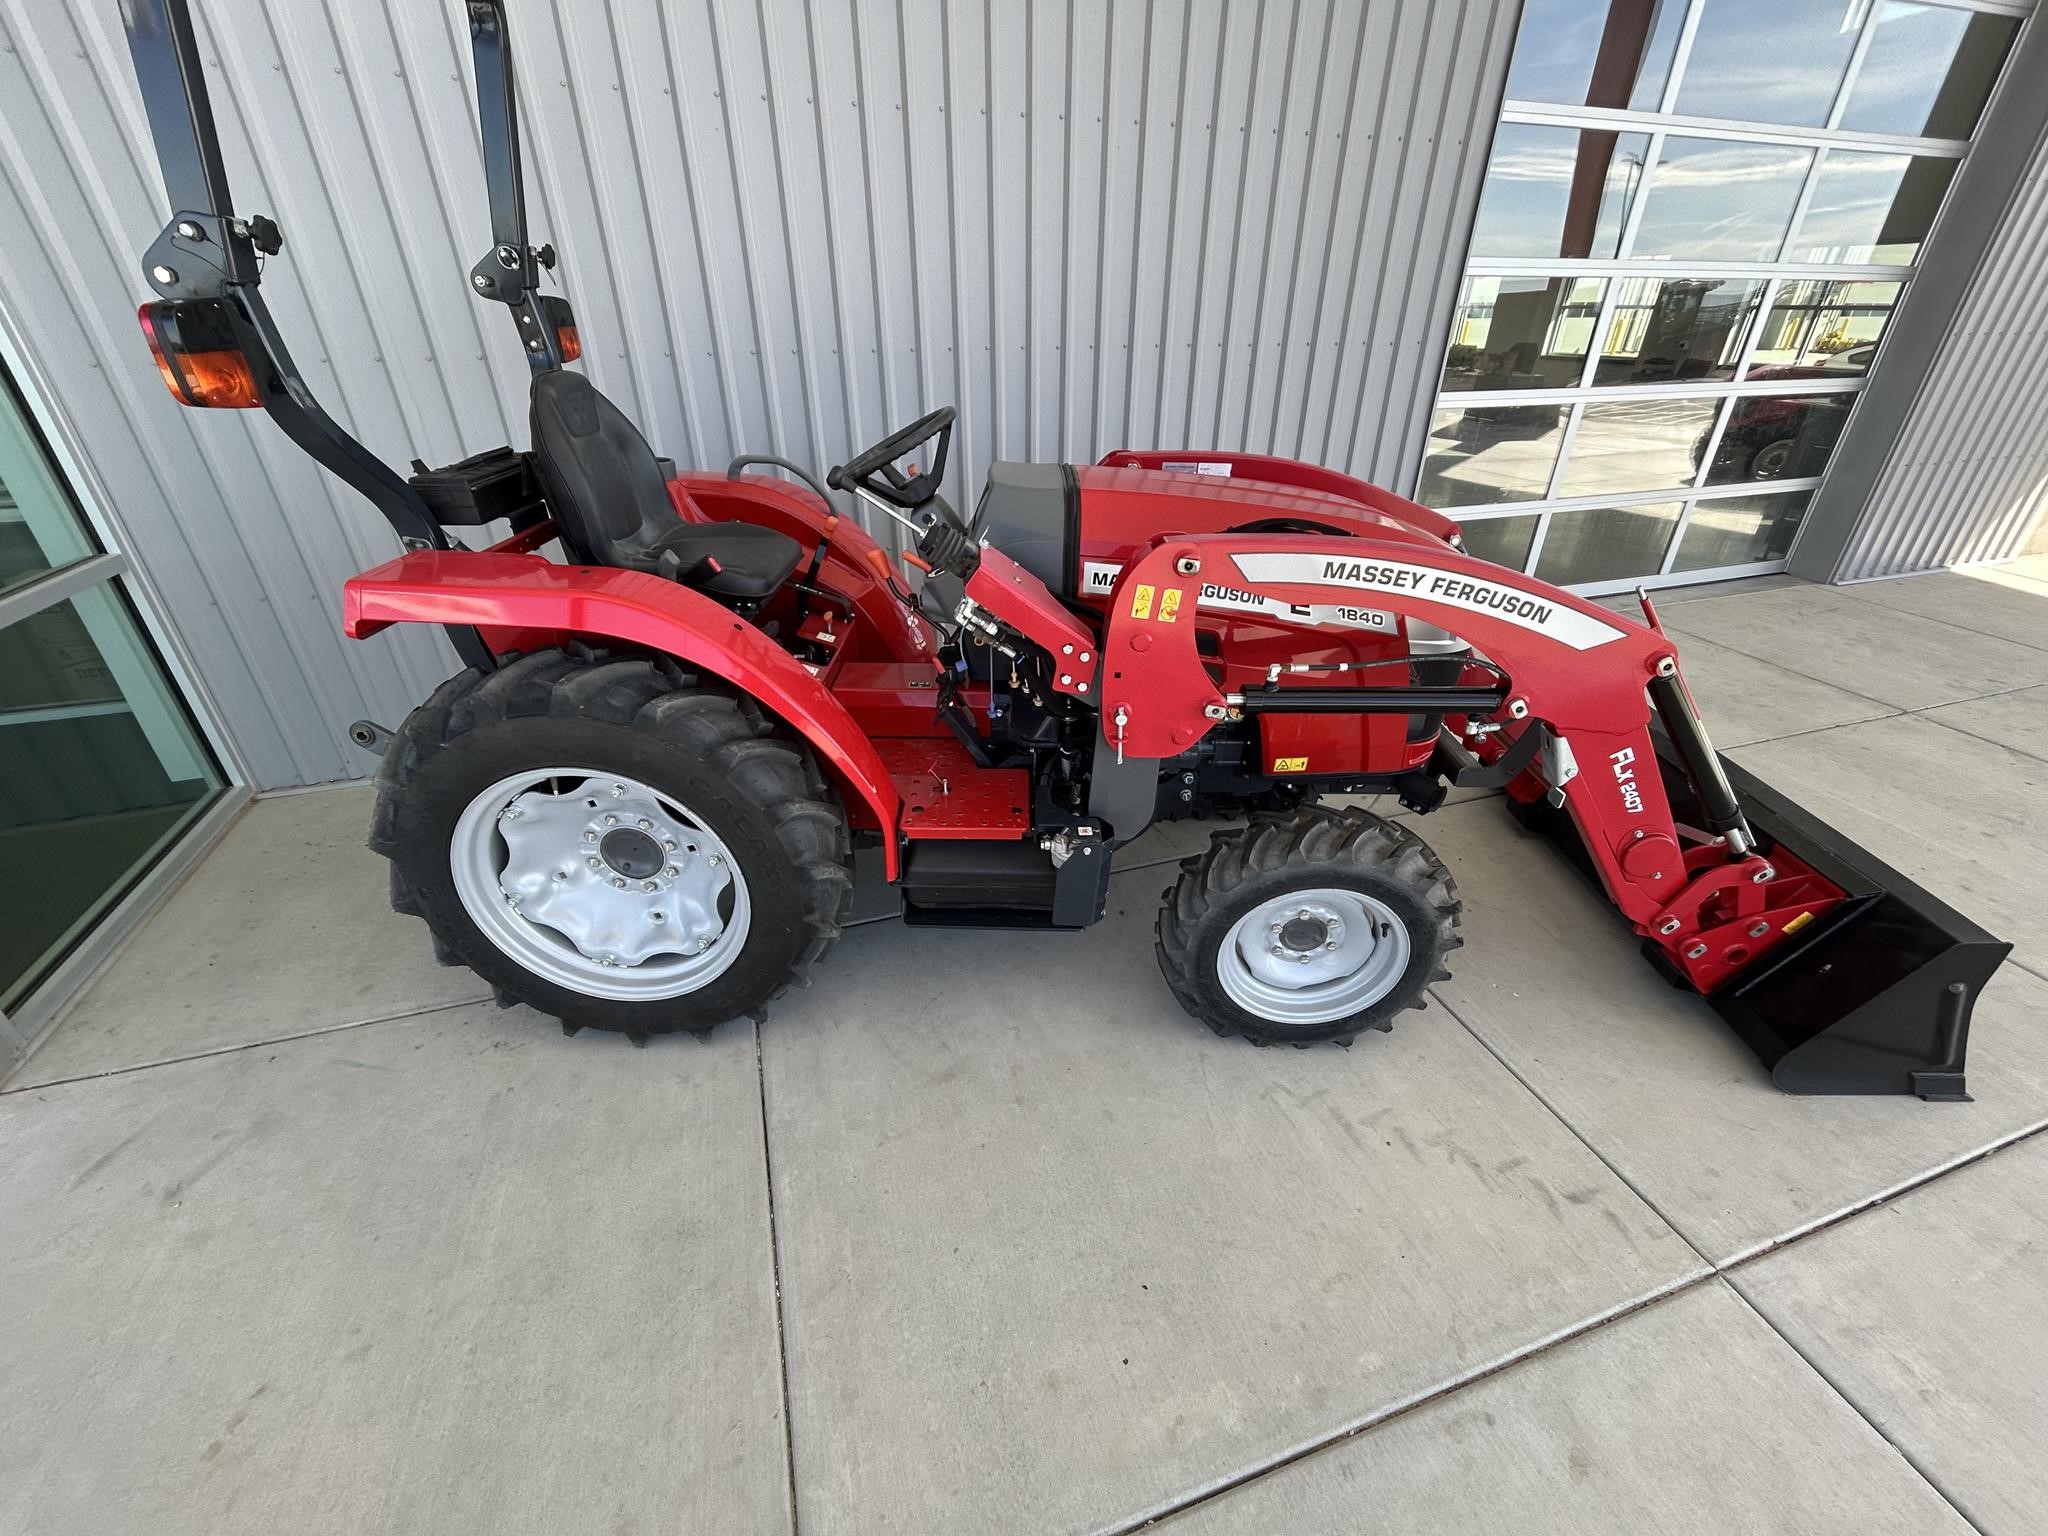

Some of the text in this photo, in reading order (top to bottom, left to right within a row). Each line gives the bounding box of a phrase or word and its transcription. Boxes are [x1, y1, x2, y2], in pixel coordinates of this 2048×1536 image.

[1322, 561, 1553, 625] MASSEY FERGUSON
[1337, 606, 1385, 627] 1840
[1620, 781, 1644, 813] 2407
